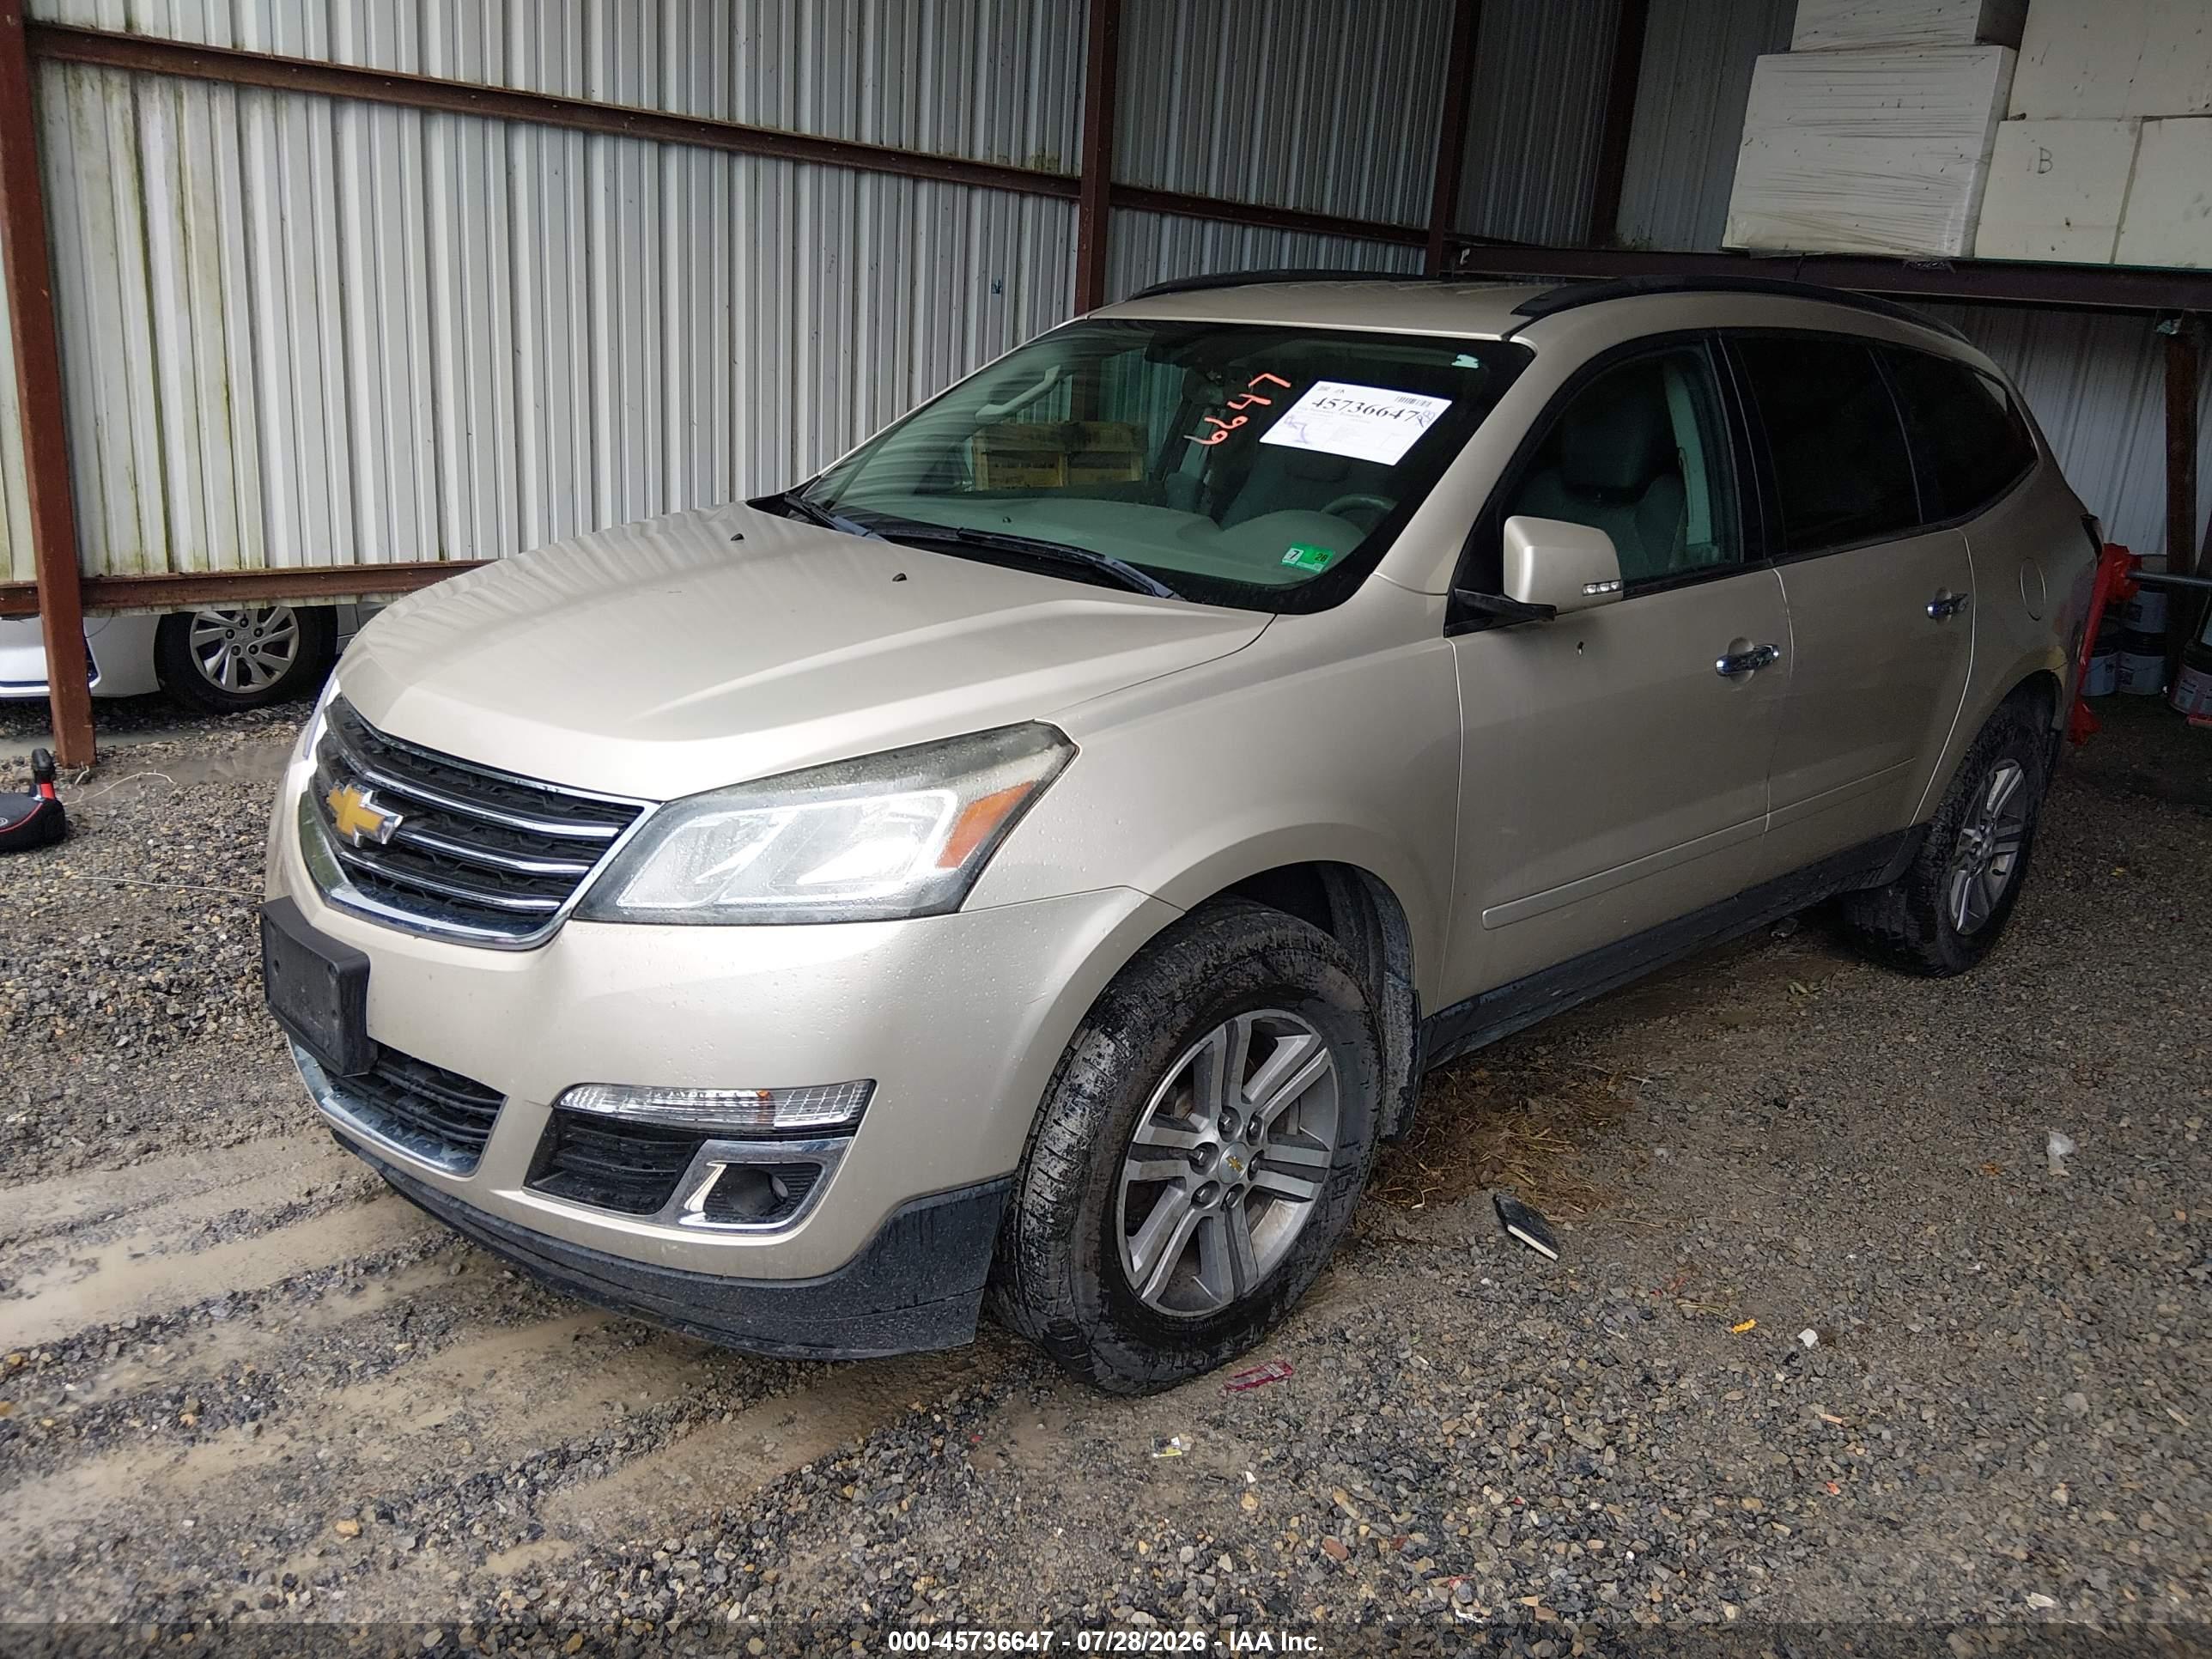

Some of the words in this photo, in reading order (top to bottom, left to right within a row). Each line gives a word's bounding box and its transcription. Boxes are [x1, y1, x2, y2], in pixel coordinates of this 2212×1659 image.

[2038, 146, 2053, 173] B
[1184, 373, 1291, 445] 6647
[1311, 397, 1420, 422] 45736647
[1290, 550, 1300, 560] 7
